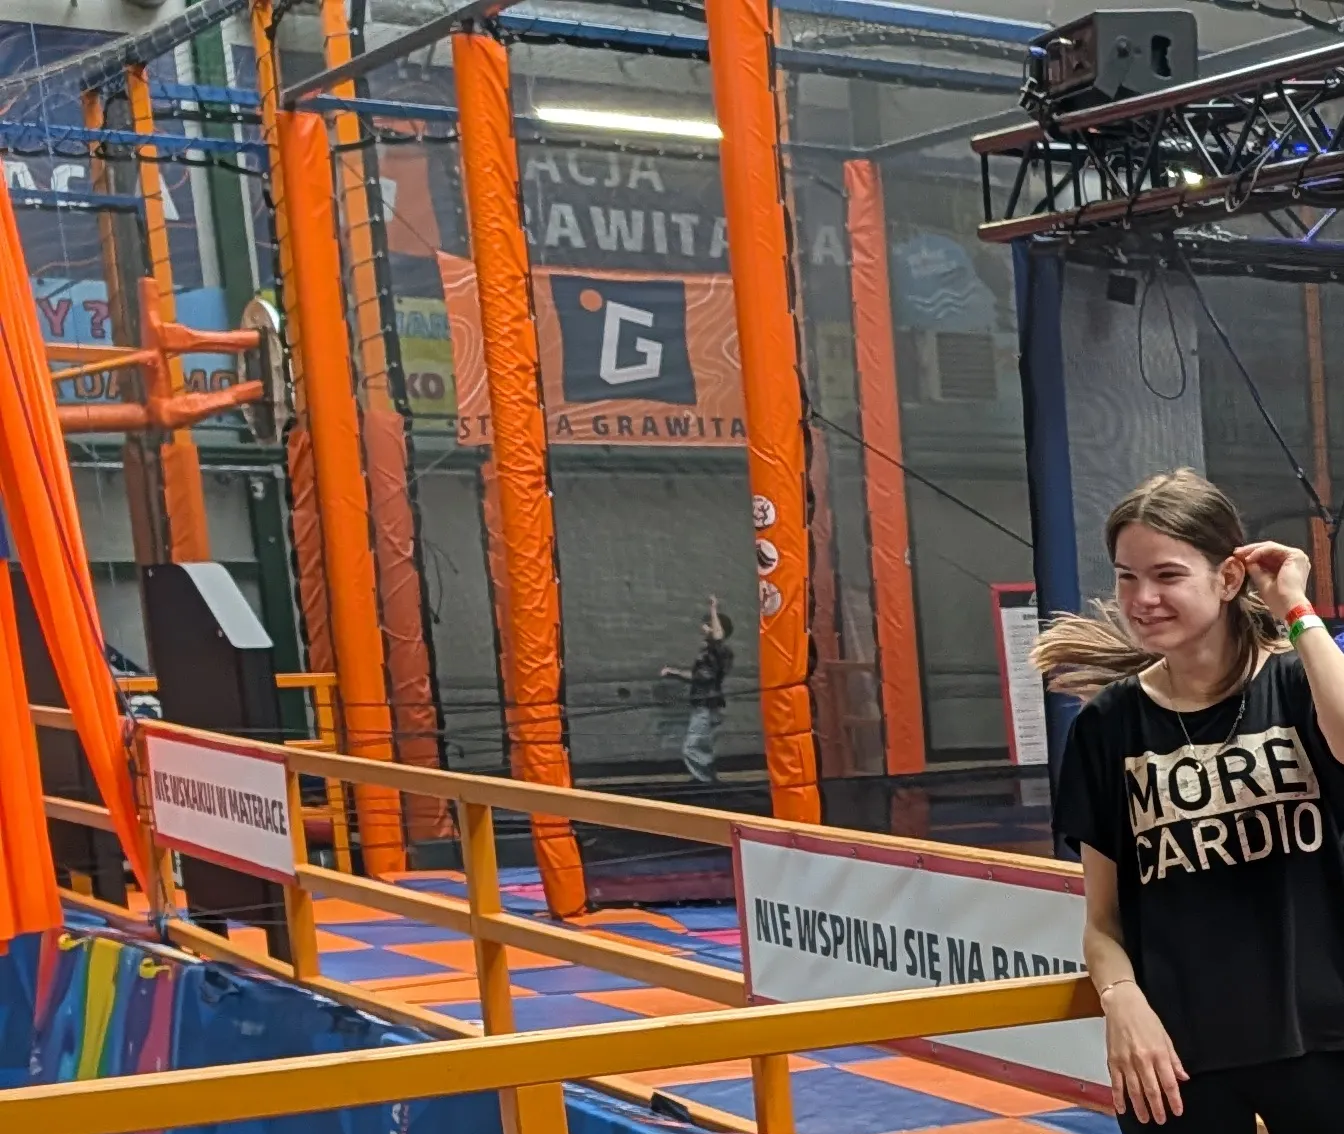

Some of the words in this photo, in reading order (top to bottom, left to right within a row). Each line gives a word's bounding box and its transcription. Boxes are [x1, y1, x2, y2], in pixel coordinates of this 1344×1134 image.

[524, 148, 666, 193] ACJA
[593, 413, 747, 438] GRAWITA
[153, 769, 171, 803] NIE
[170, 774, 217, 816] WSKAKUJ
[215, 785, 228, 819] W
[228, 788, 288, 836] MATERACE
[1125, 737, 1308, 828] MORE
[1136, 801, 1323, 885] CARDIO
[754, 897, 793, 948] NIE
[795, 906, 898, 972] WSPINAJ
[904, 928, 942, 987] SIĘ
[946, 937, 986, 985] NA
